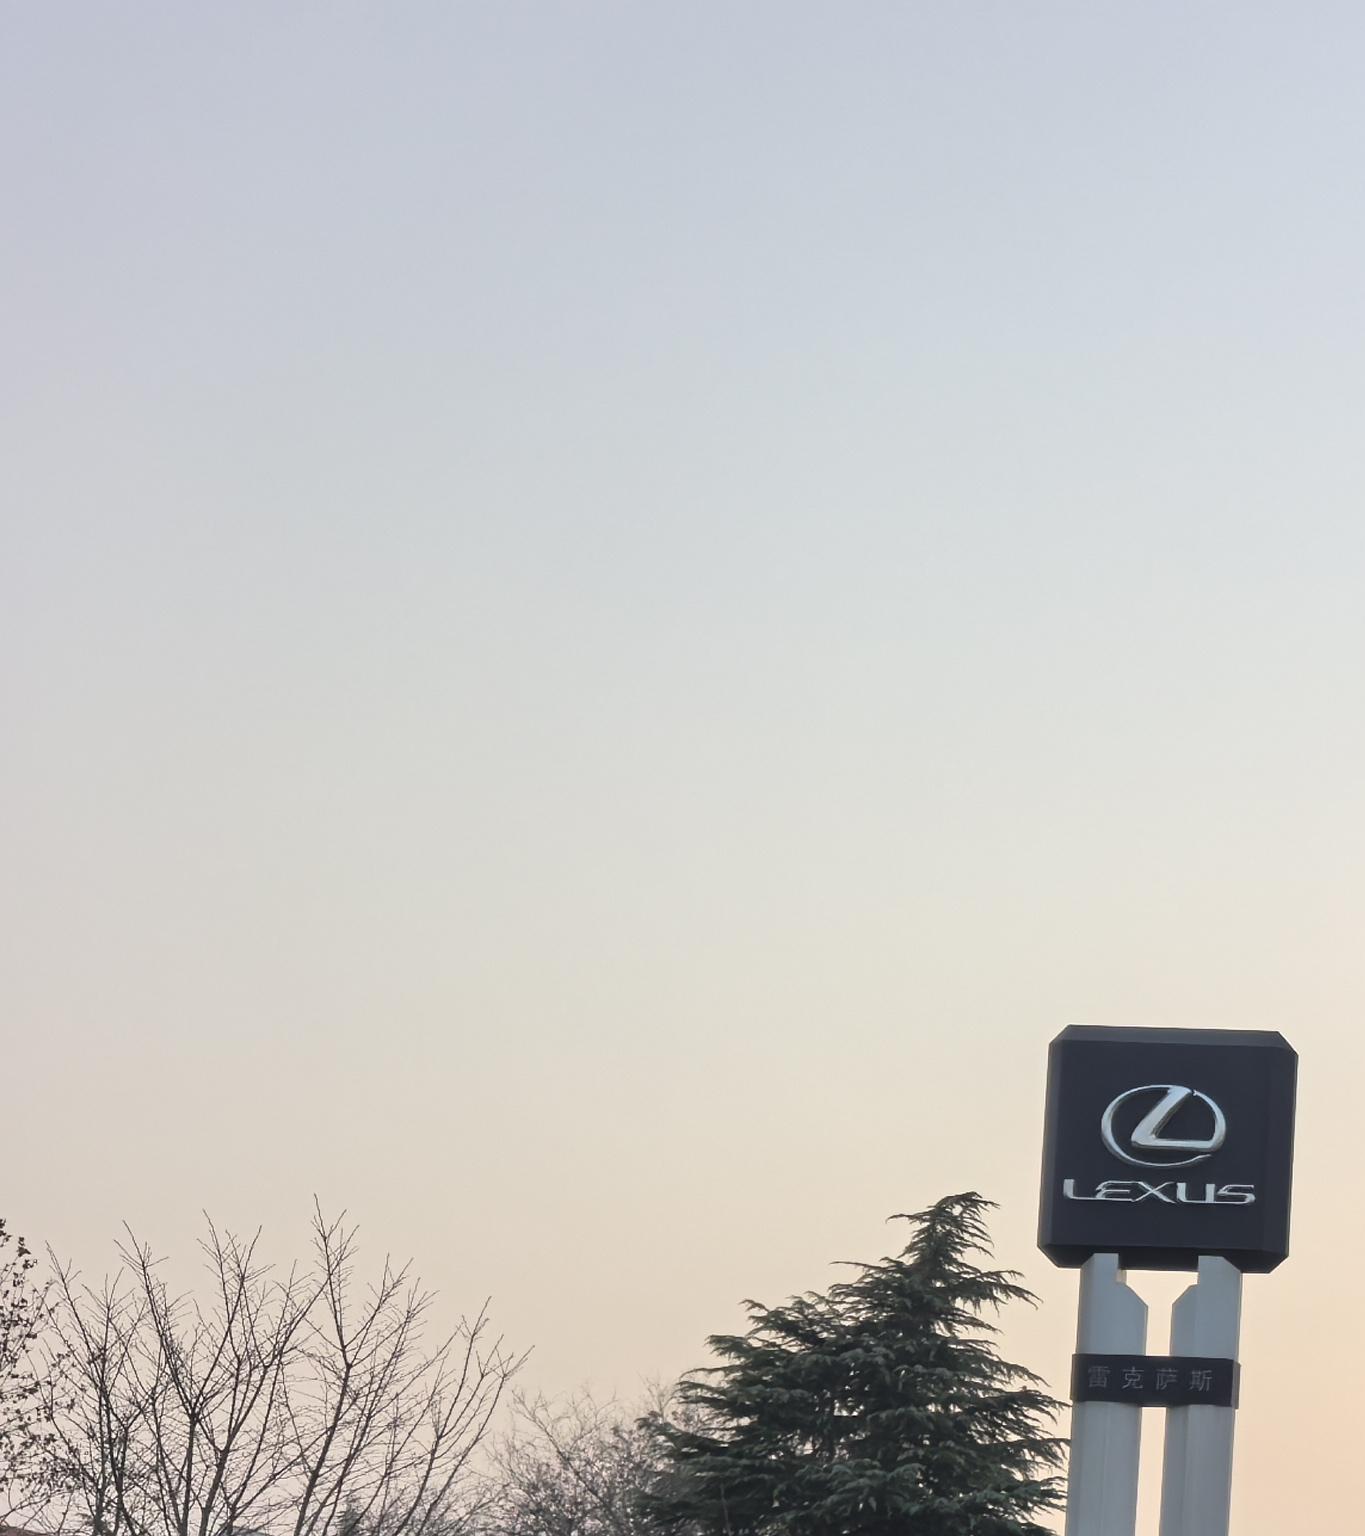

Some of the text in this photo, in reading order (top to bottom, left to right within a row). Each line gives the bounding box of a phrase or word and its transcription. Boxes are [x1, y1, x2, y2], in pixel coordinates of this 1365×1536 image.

[1062, 1177, 1257, 1206] LEXUS
[1087, 1366, 1213, 1393] 雷克萨斯
